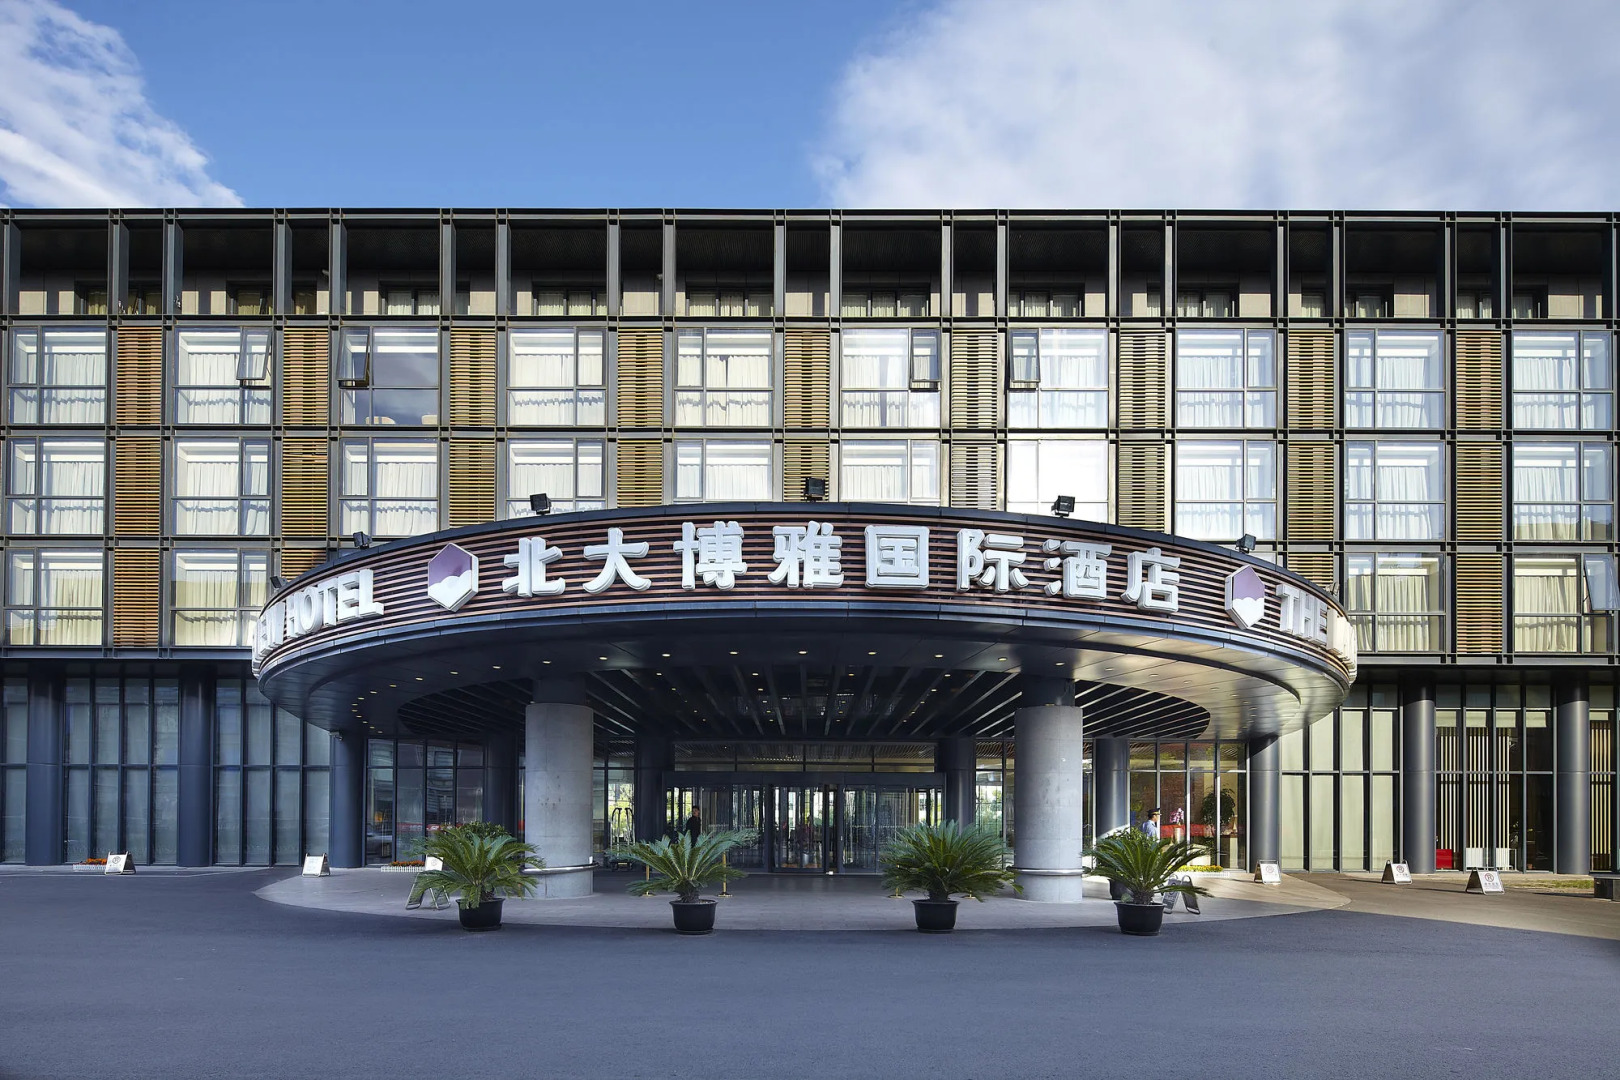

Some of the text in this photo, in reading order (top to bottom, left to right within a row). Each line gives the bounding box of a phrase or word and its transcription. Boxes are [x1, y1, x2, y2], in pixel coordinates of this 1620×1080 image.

[286, 568, 385, 639] HOTEL
[502, 520, 1181, 613] 北大博雅国际酒店
